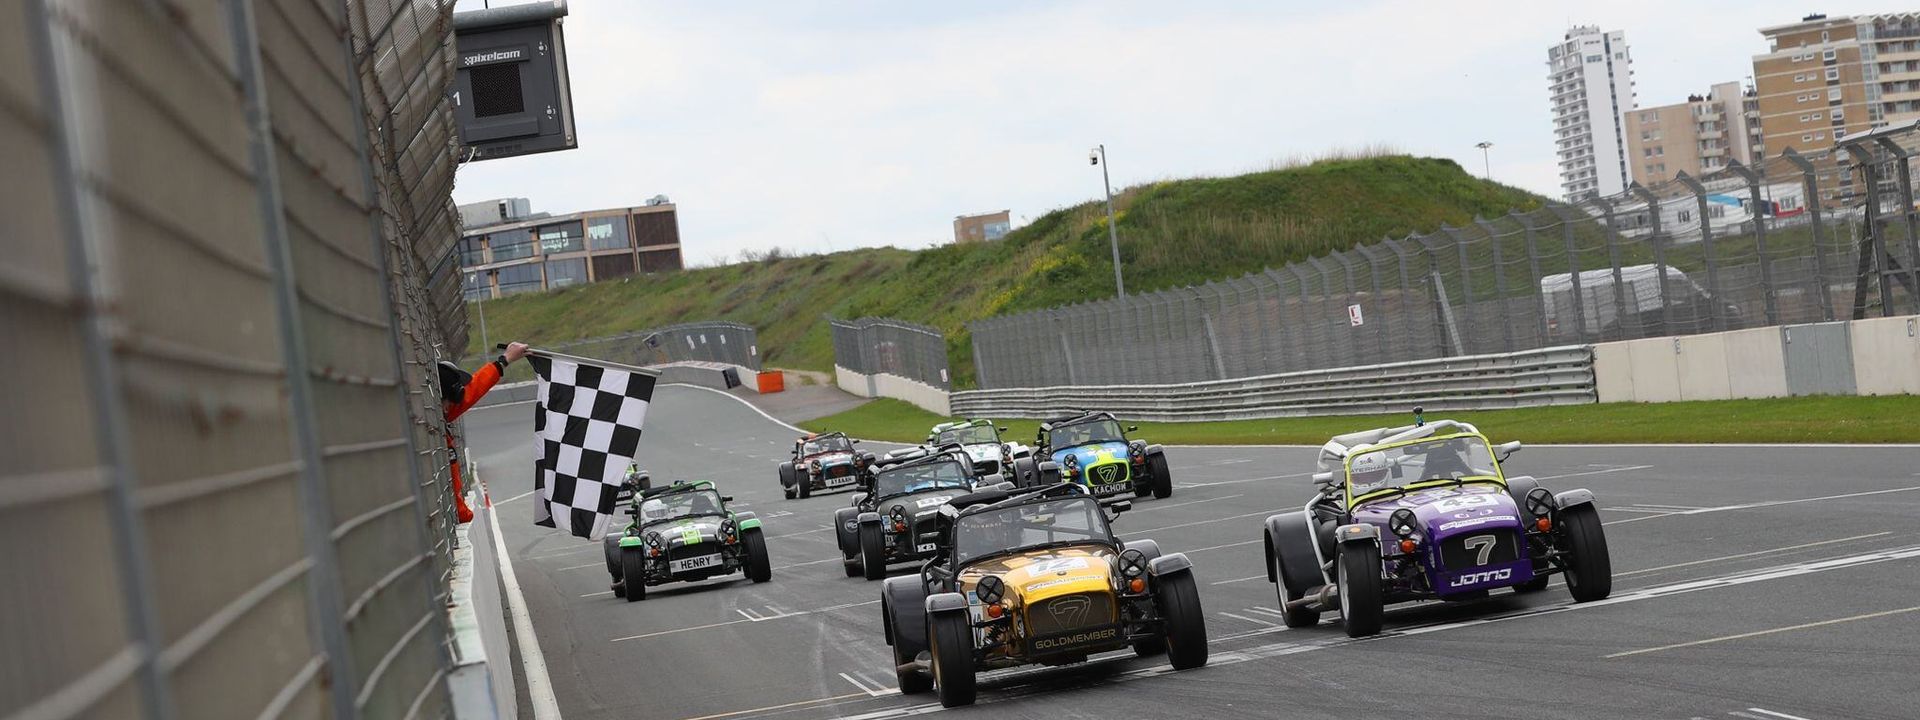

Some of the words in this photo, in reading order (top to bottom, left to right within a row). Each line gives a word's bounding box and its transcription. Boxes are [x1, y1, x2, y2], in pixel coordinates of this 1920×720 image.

[470, 50, 521, 65] pixelcom
[1464, 534, 1496, 566] 7
[680, 556, 711, 570] HENRY
[1450, 568, 1512, 587] JONNO
[1054, 599, 1087, 628] 7
[1035, 628, 1116, 650] GOLDMEMBER
